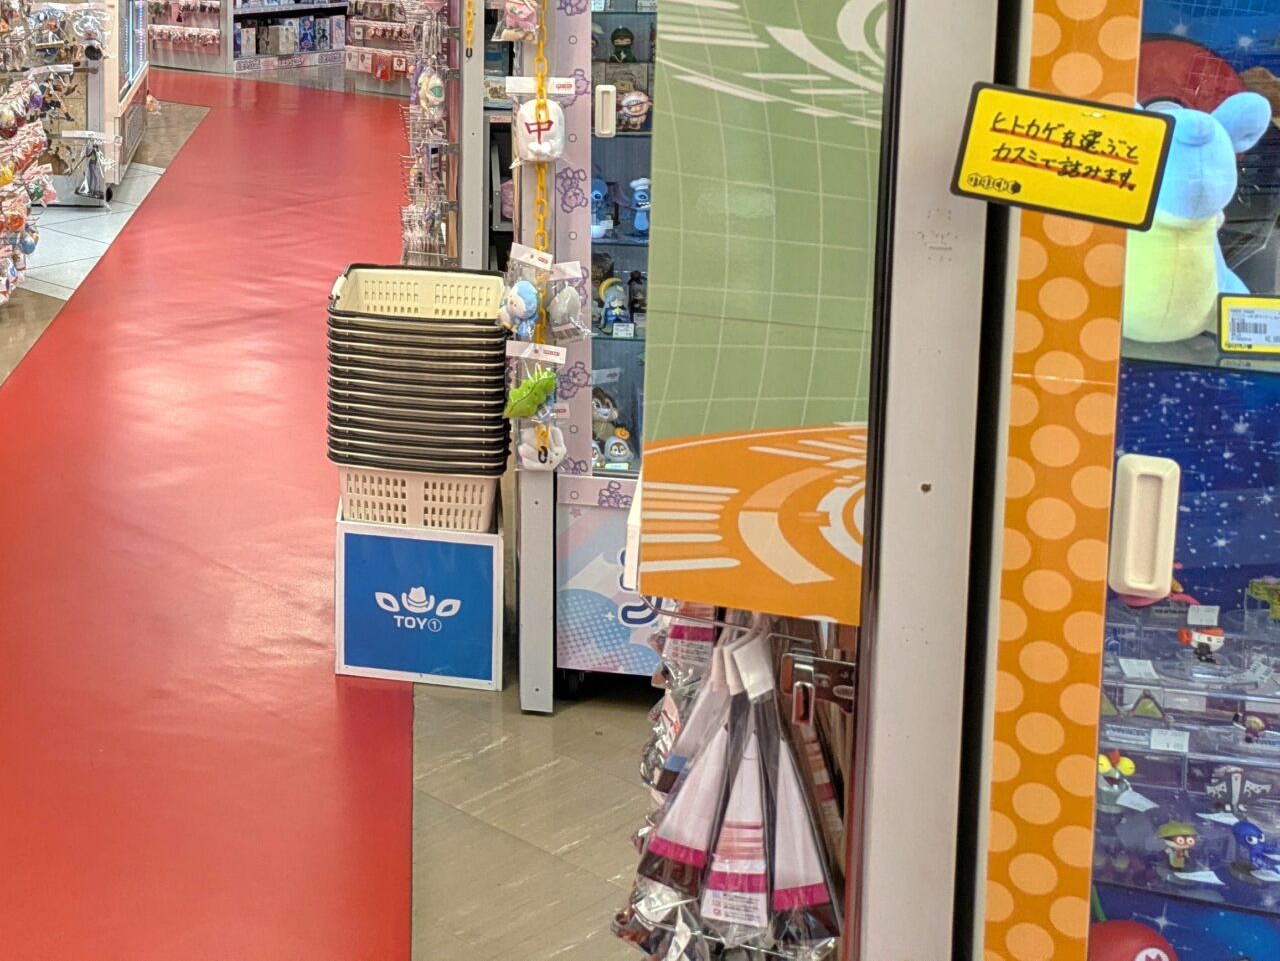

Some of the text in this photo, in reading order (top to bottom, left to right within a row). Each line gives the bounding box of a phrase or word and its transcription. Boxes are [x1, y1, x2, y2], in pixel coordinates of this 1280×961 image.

[991, 112, 1139, 160] ヒトカゲを選ぶと
